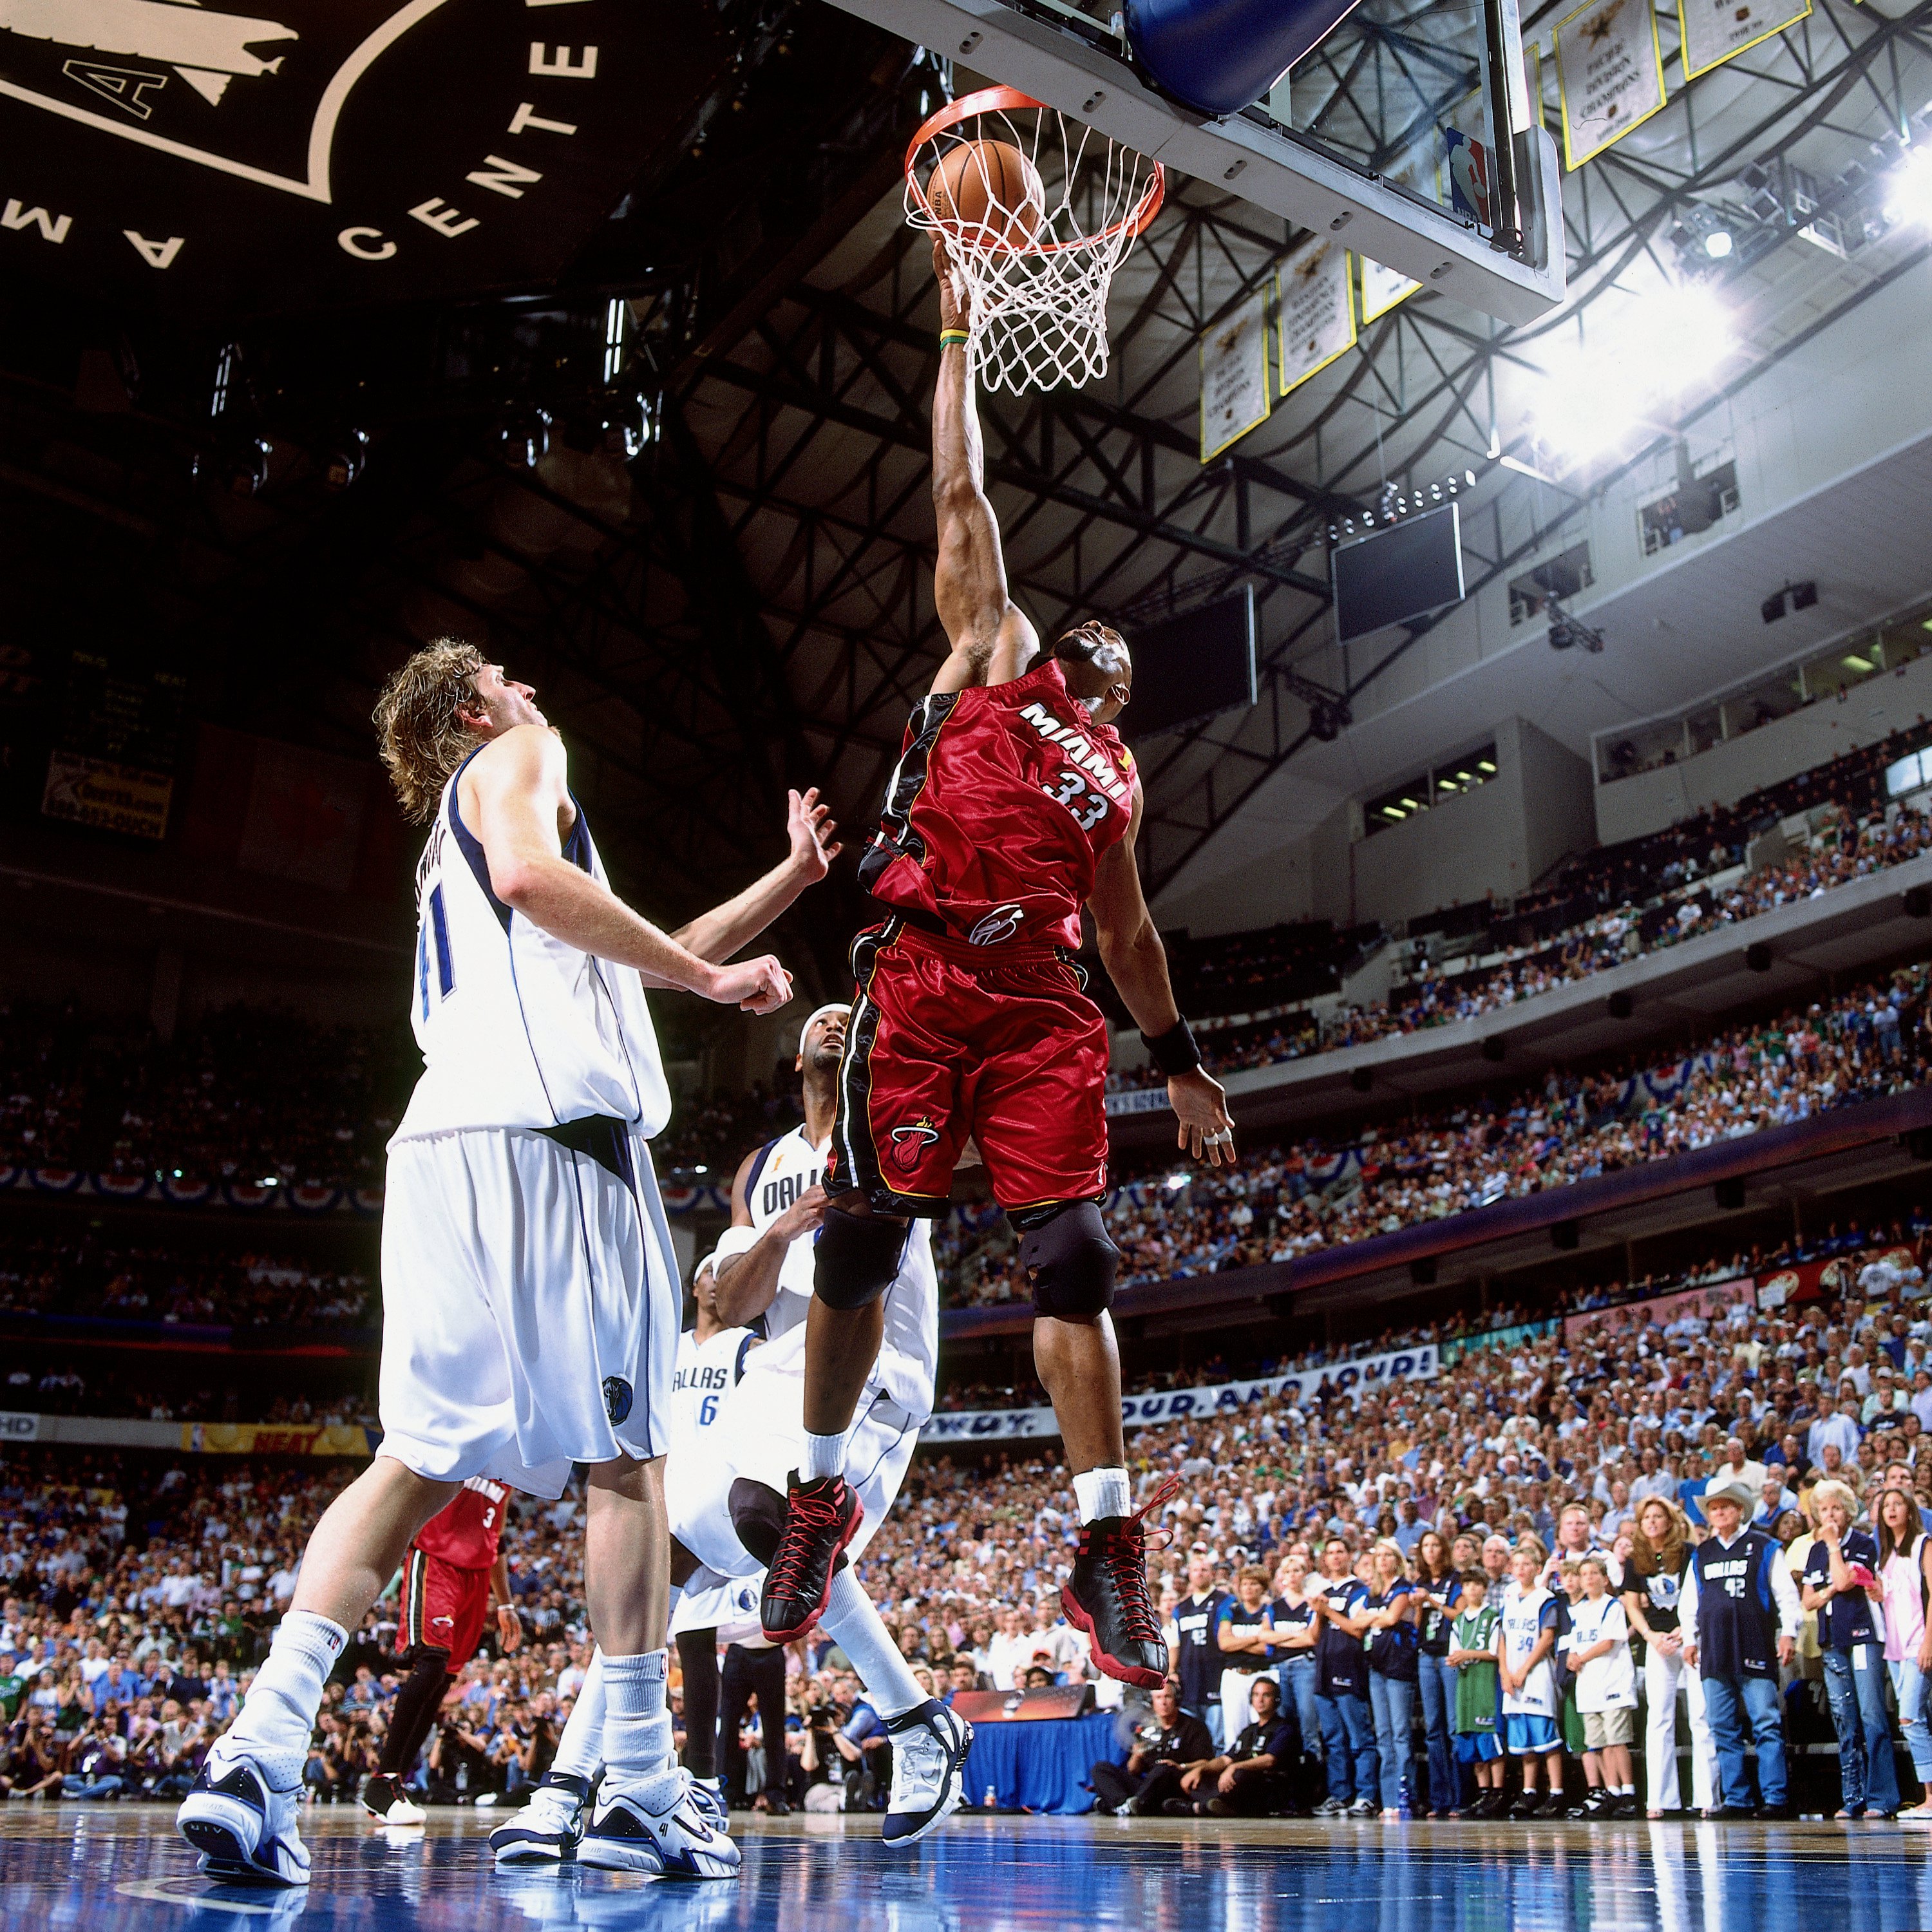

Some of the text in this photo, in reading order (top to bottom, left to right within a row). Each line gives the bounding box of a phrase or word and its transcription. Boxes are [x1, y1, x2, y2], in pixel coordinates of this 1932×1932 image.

[337, 0, 600, 261] CENTE
[934, 191, 943, 215] NBA
[1019, 702, 1127, 799] MIAMI
[1042, 771, 1110, 831] 33
[763, 1168, 817, 1217] DALL
[672, 1367, 728, 1392] ALLAS
[699, 1395, 719, 1426] 6
[253, 1425, 326, 1453] HEAT
[482, 1507, 496, 1529] 3
[1724, 1577, 1746, 1598] 42
[659, 1823, 668, 1837] 41
